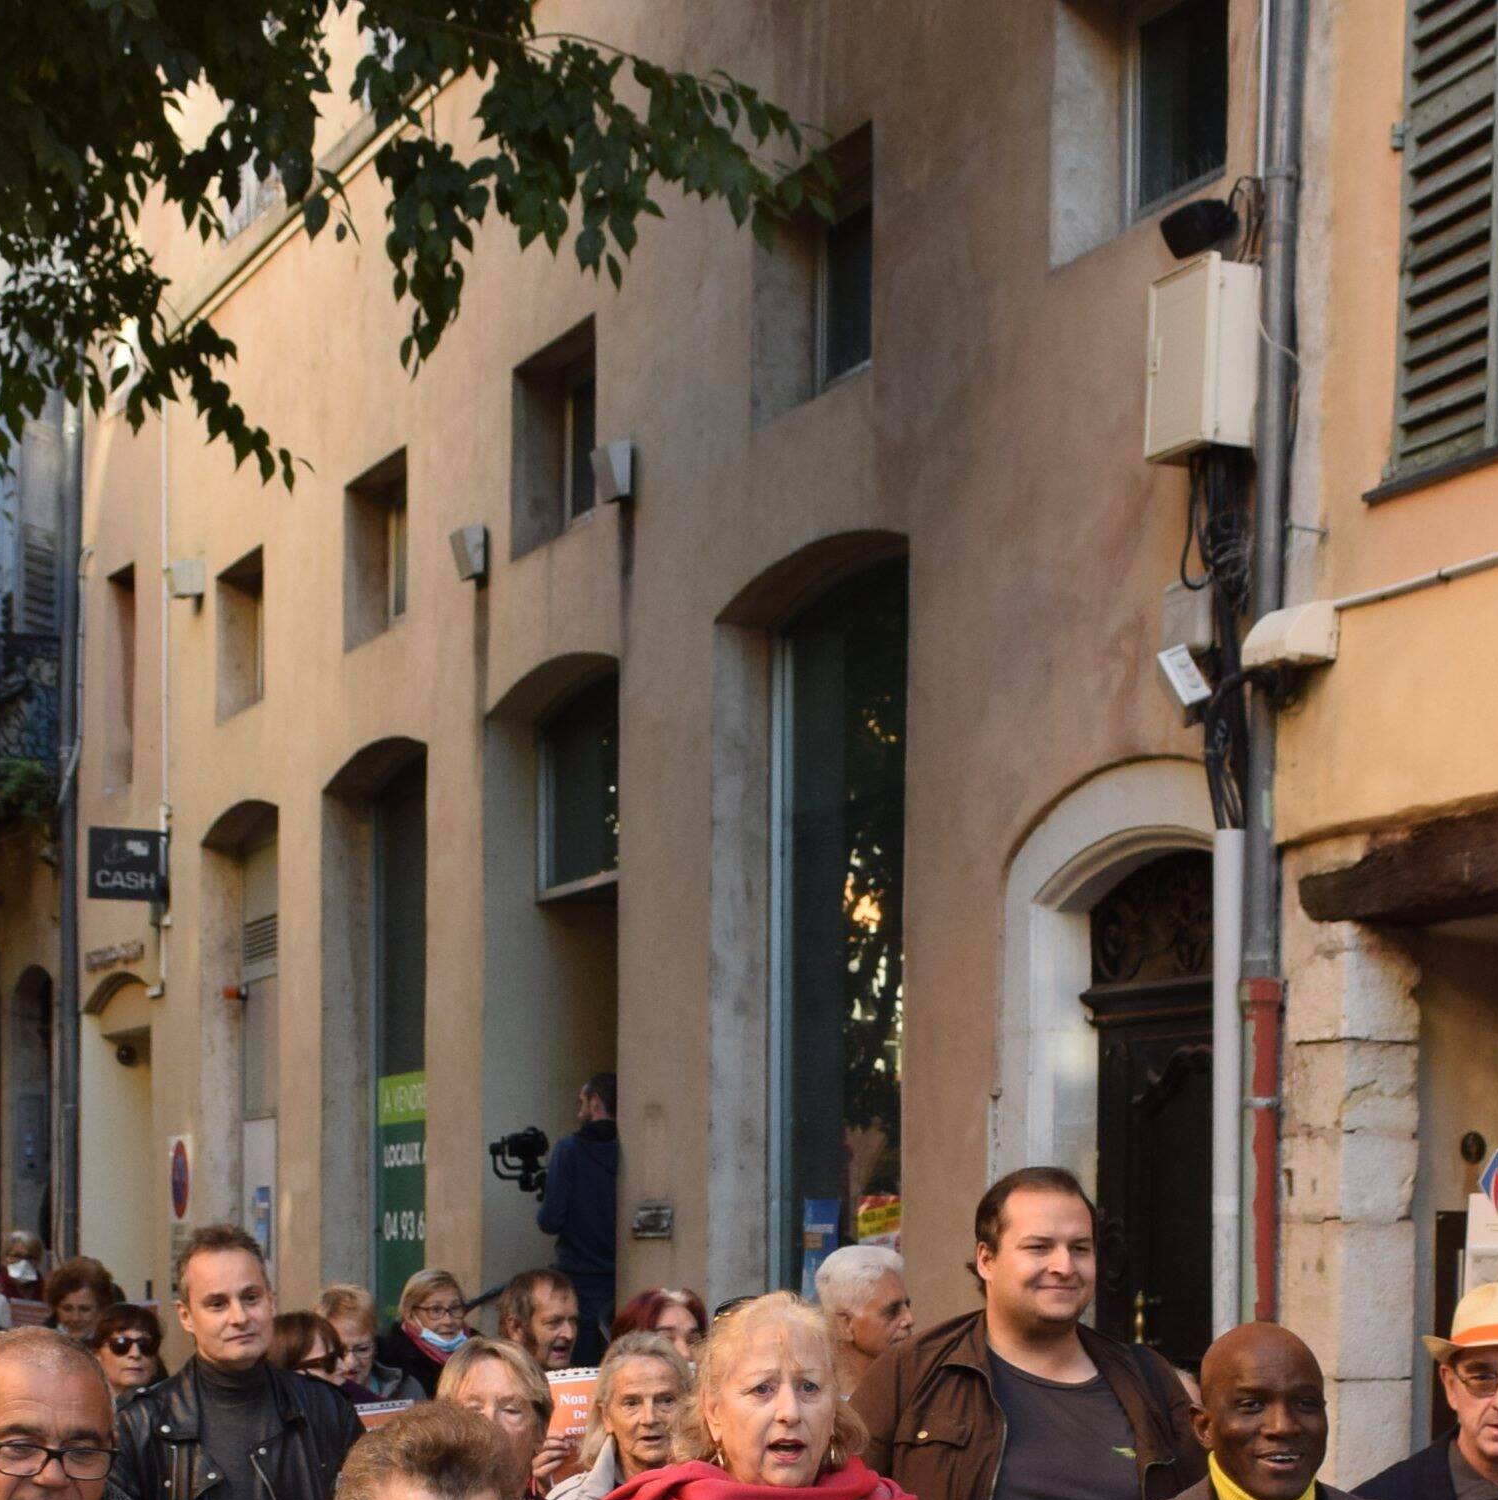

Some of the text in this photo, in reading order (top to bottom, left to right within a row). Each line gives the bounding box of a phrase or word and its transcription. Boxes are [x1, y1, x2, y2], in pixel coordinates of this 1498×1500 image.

[95, 869, 156, 890] CASH
[383, 1142, 421, 1168] LOCAUX
[383, 1212, 399, 1241] 04
[401, 1212, 415, 1241] 93
[559, 1393, 588, 1406] Non
[572, 1409, 588, 1420] De
